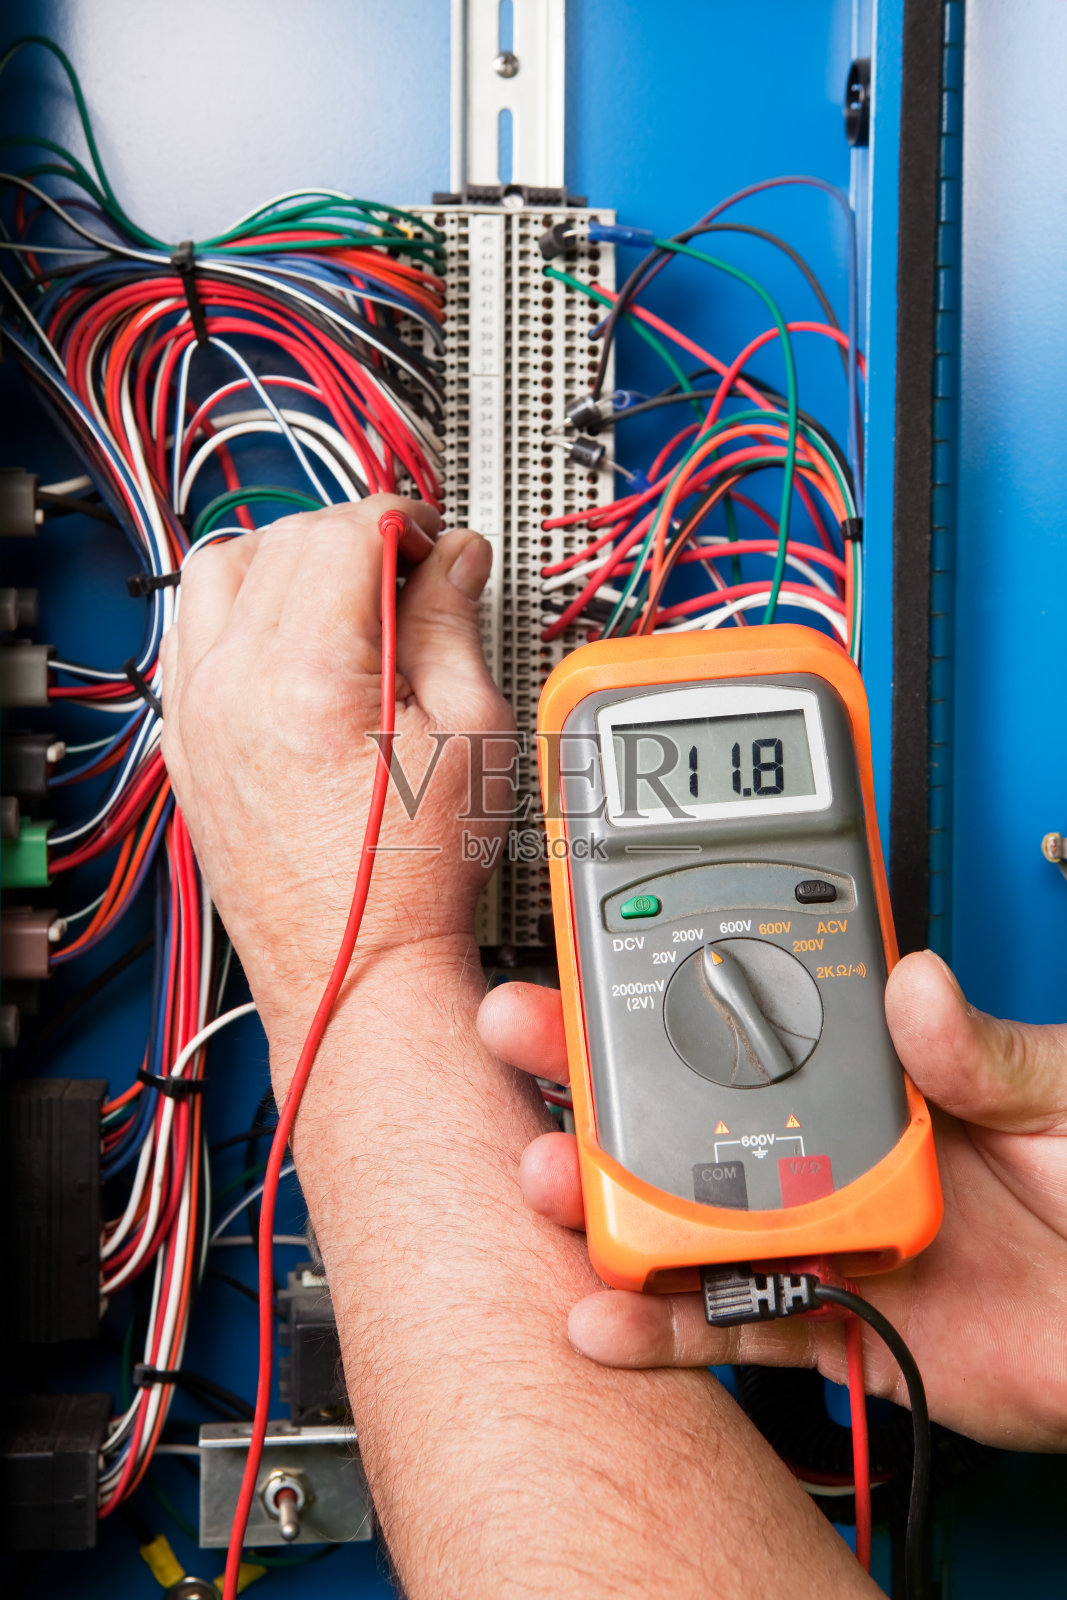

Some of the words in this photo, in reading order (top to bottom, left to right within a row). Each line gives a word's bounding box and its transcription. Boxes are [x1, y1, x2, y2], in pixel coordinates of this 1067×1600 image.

[689, 737, 784, 798] 11.8
[719, 919, 752, 934] 600V
[758, 921, 792, 935] 600V
[816, 920, 848, 934] ACV
[672, 928, 704, 943] 200V
[613, 936, 645, 952] DCV
[792, 938, 825, 952] 200V
[652, 951, 677, 965] 20V
[611, 980, 665, 997] 2000mV
[626, 996, 655, 1012] (2V)
[741, 1133, 776, 1147] 600V
[701, 1166, 737, 1182] COM
